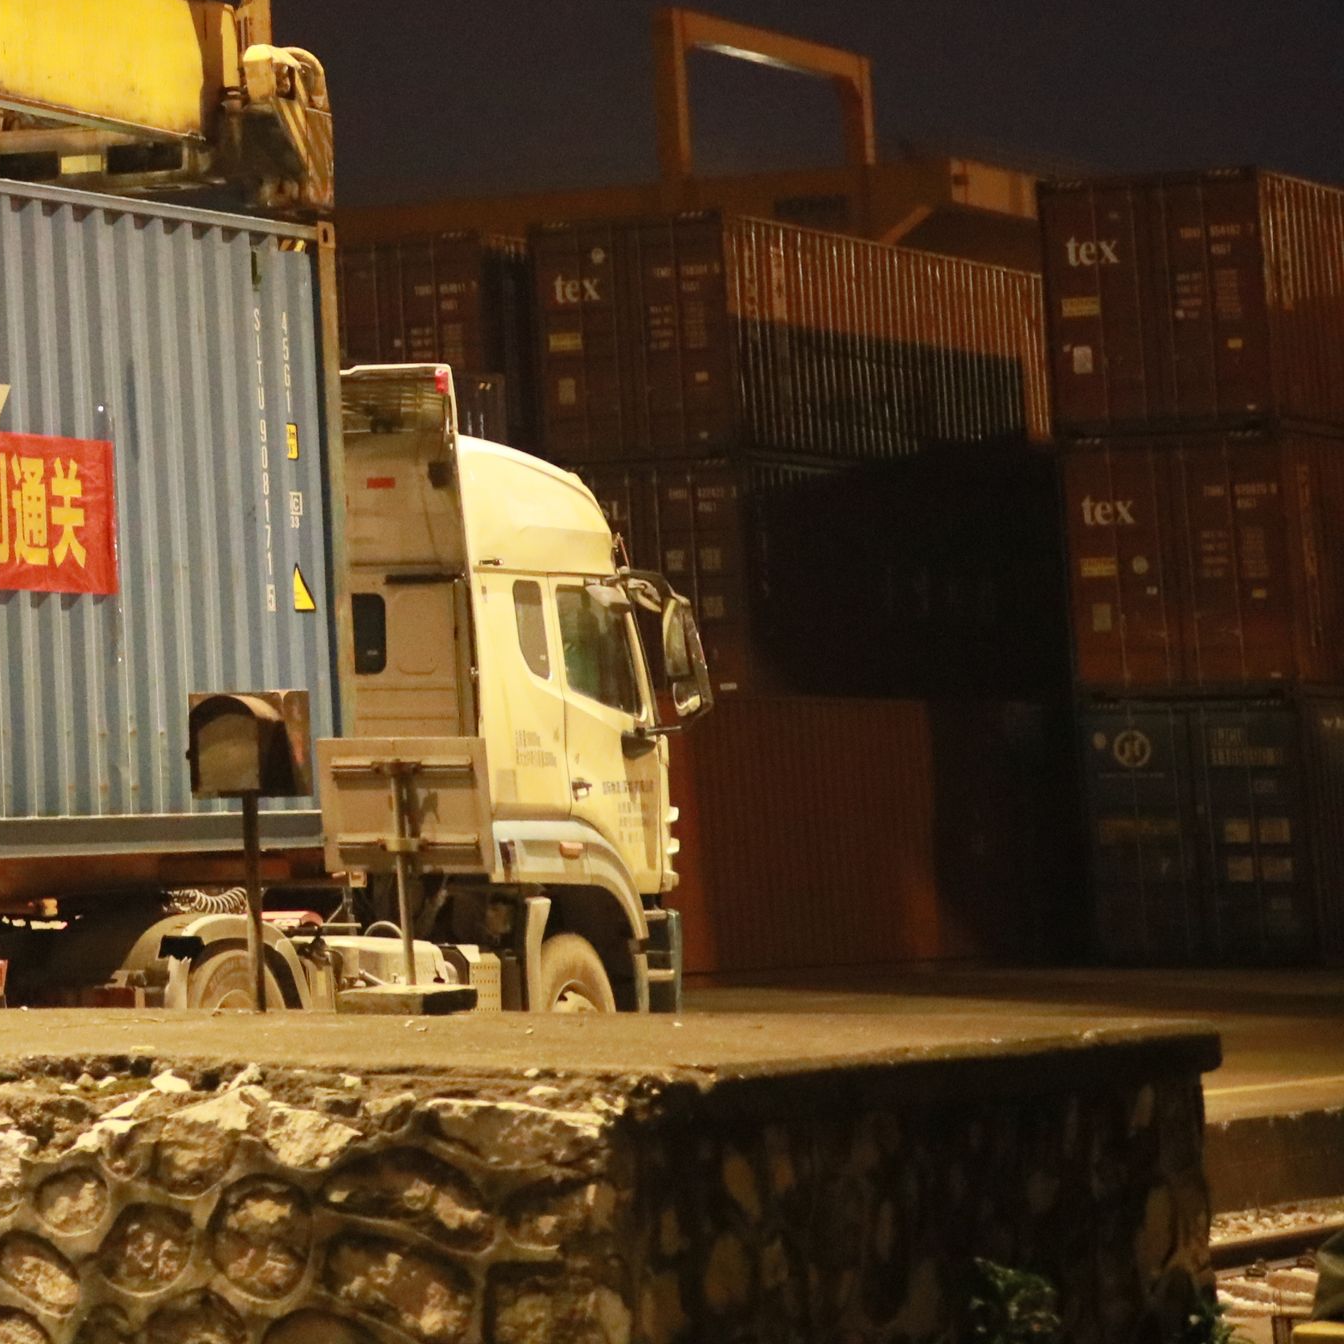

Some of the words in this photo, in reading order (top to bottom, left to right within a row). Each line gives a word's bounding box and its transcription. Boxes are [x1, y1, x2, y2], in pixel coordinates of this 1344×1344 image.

[1065, 236, 1120, 267] tex
[553, 273, 601, 304] tex
[253, 307, 265, 410] SITU
[259, 419, 272, 576] 908171
[1080, 495, 1136, 526] tex
